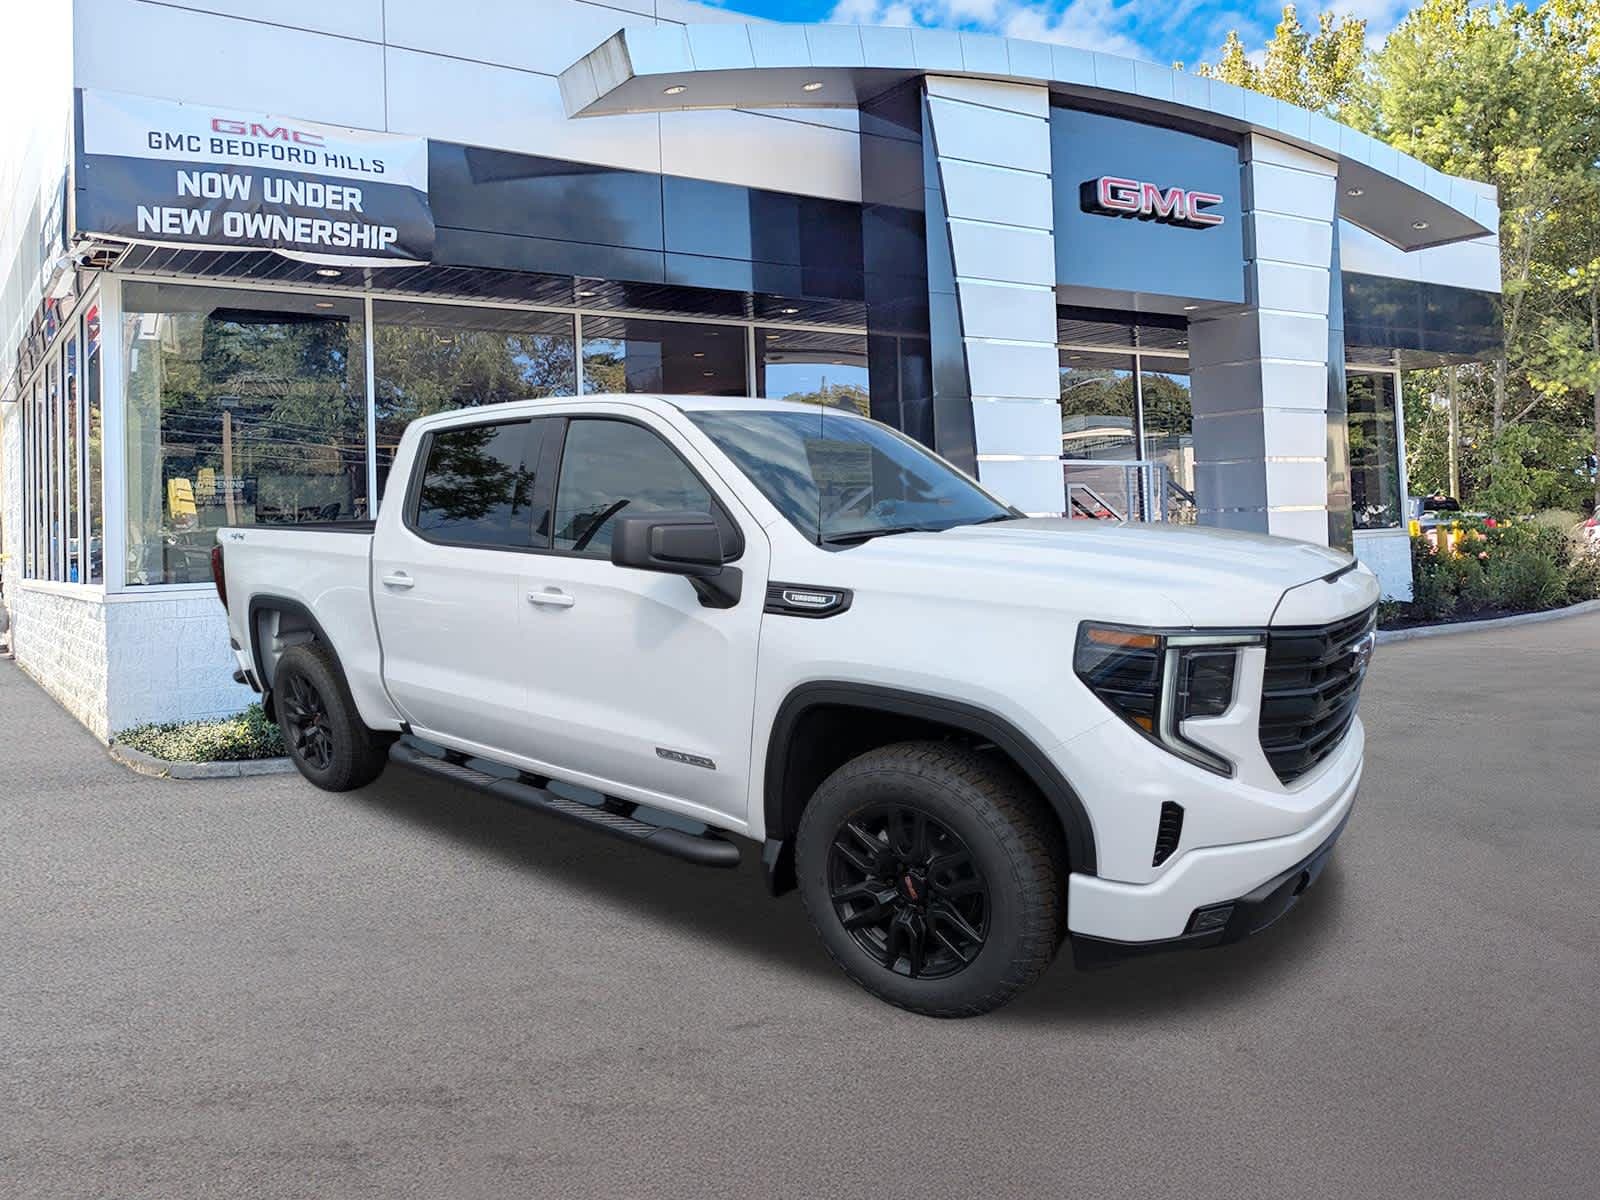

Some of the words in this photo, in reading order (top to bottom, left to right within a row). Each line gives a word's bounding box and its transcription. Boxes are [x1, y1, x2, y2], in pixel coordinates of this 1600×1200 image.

[148, 131, 200, 152] GMC
[210, 138, 316, 165] BEDFORD
[325, 152, 385, 174] HILLS
[211, 118, 325, 147] GMC
[177, 170, 252, 201] NOW
[264, 177, 363, 212] UNDER
[1097, 175, 1225, 225] GMC
[136, 205, 211, 236] NEW
[223, 211, 398, 249] OWNERSHIP
